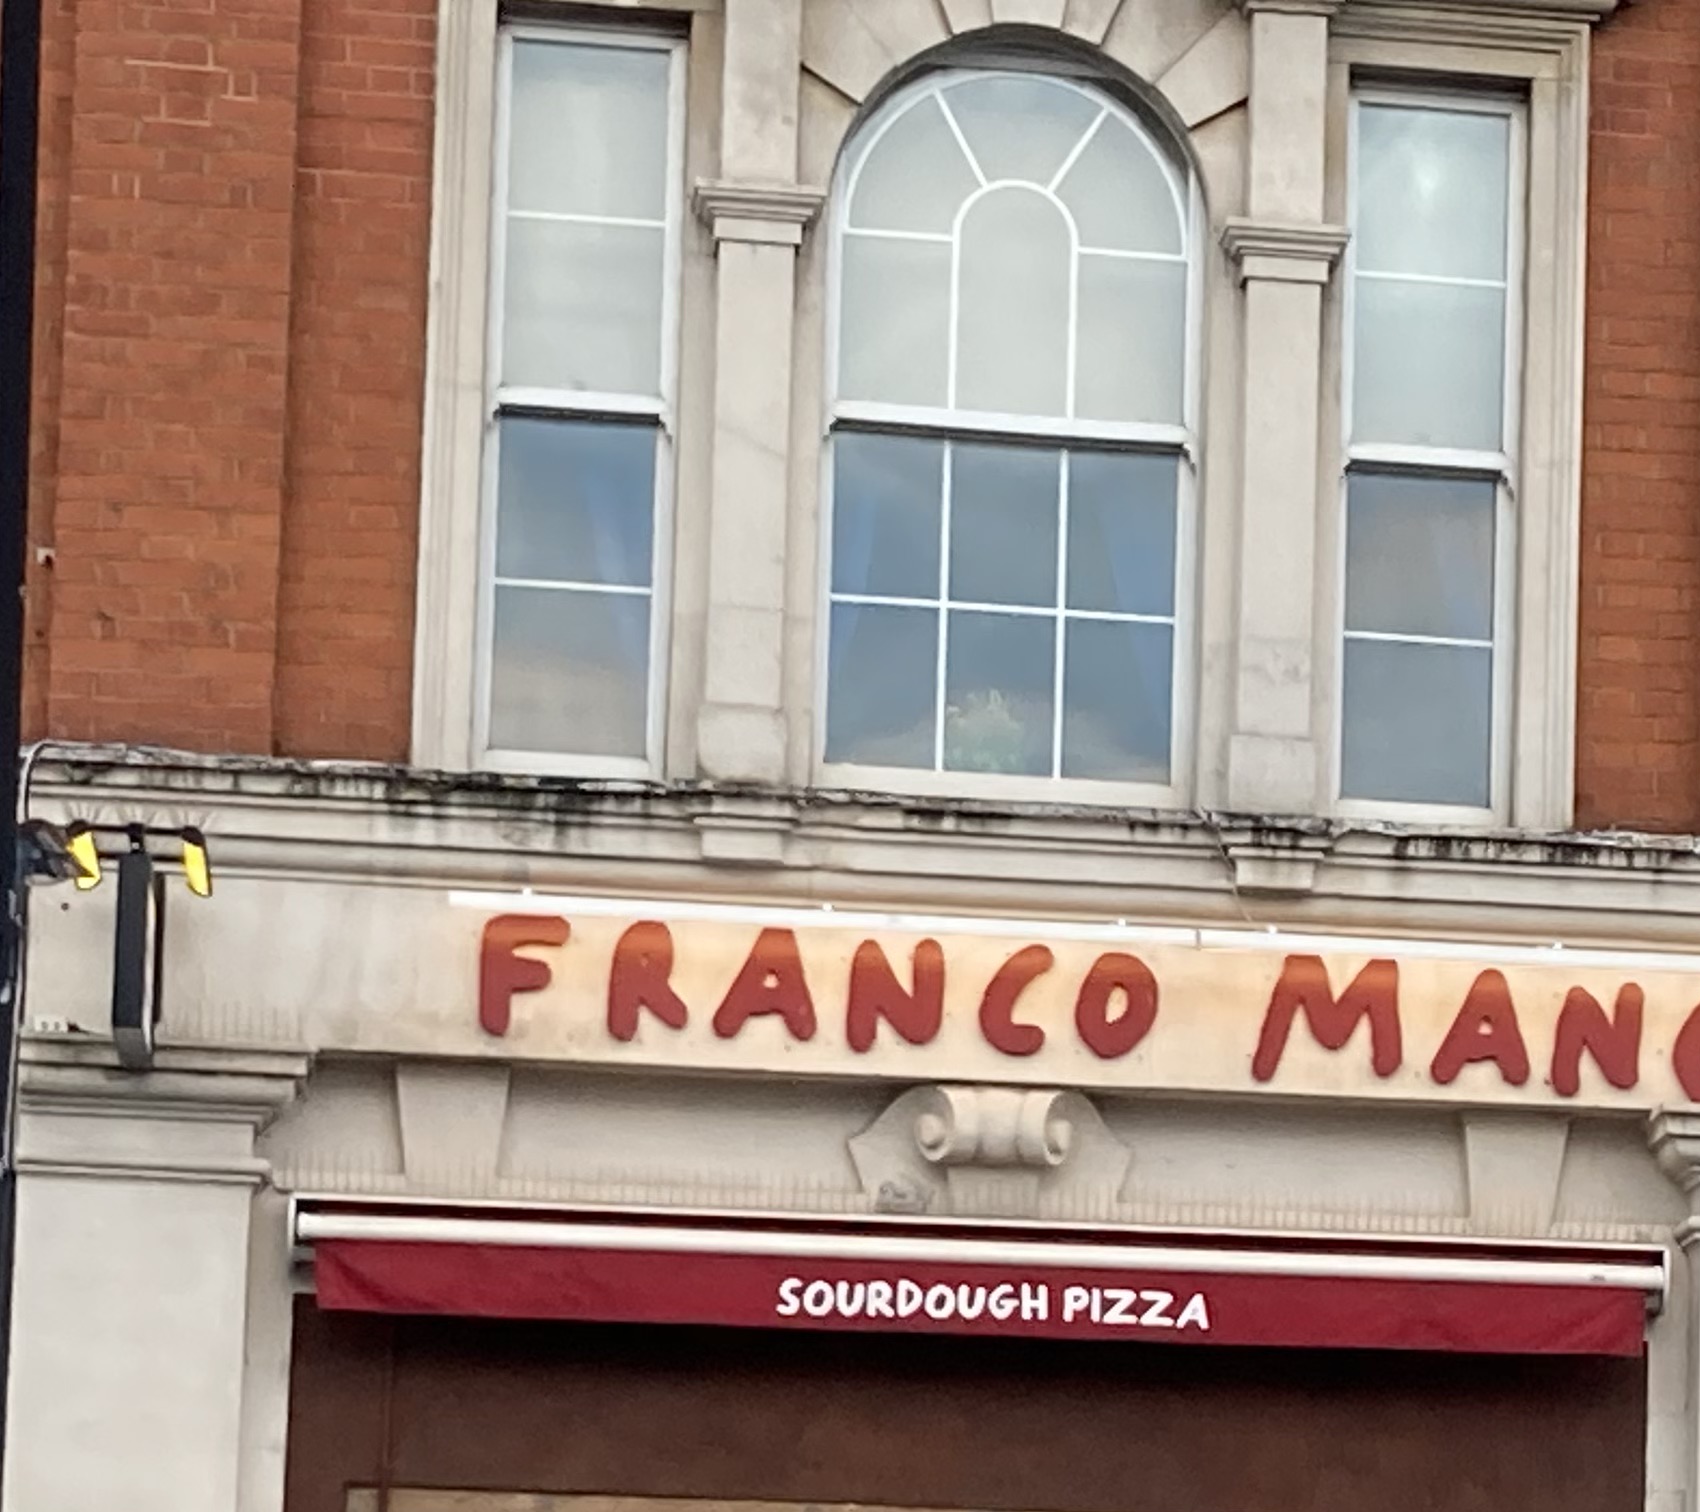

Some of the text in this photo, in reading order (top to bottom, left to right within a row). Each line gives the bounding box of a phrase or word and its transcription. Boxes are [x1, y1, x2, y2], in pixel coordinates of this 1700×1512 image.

[478, 914, 1160, 1060] FRANCO
[776, 1277, 1210, 1330] SOURDOUGH PIZZA
